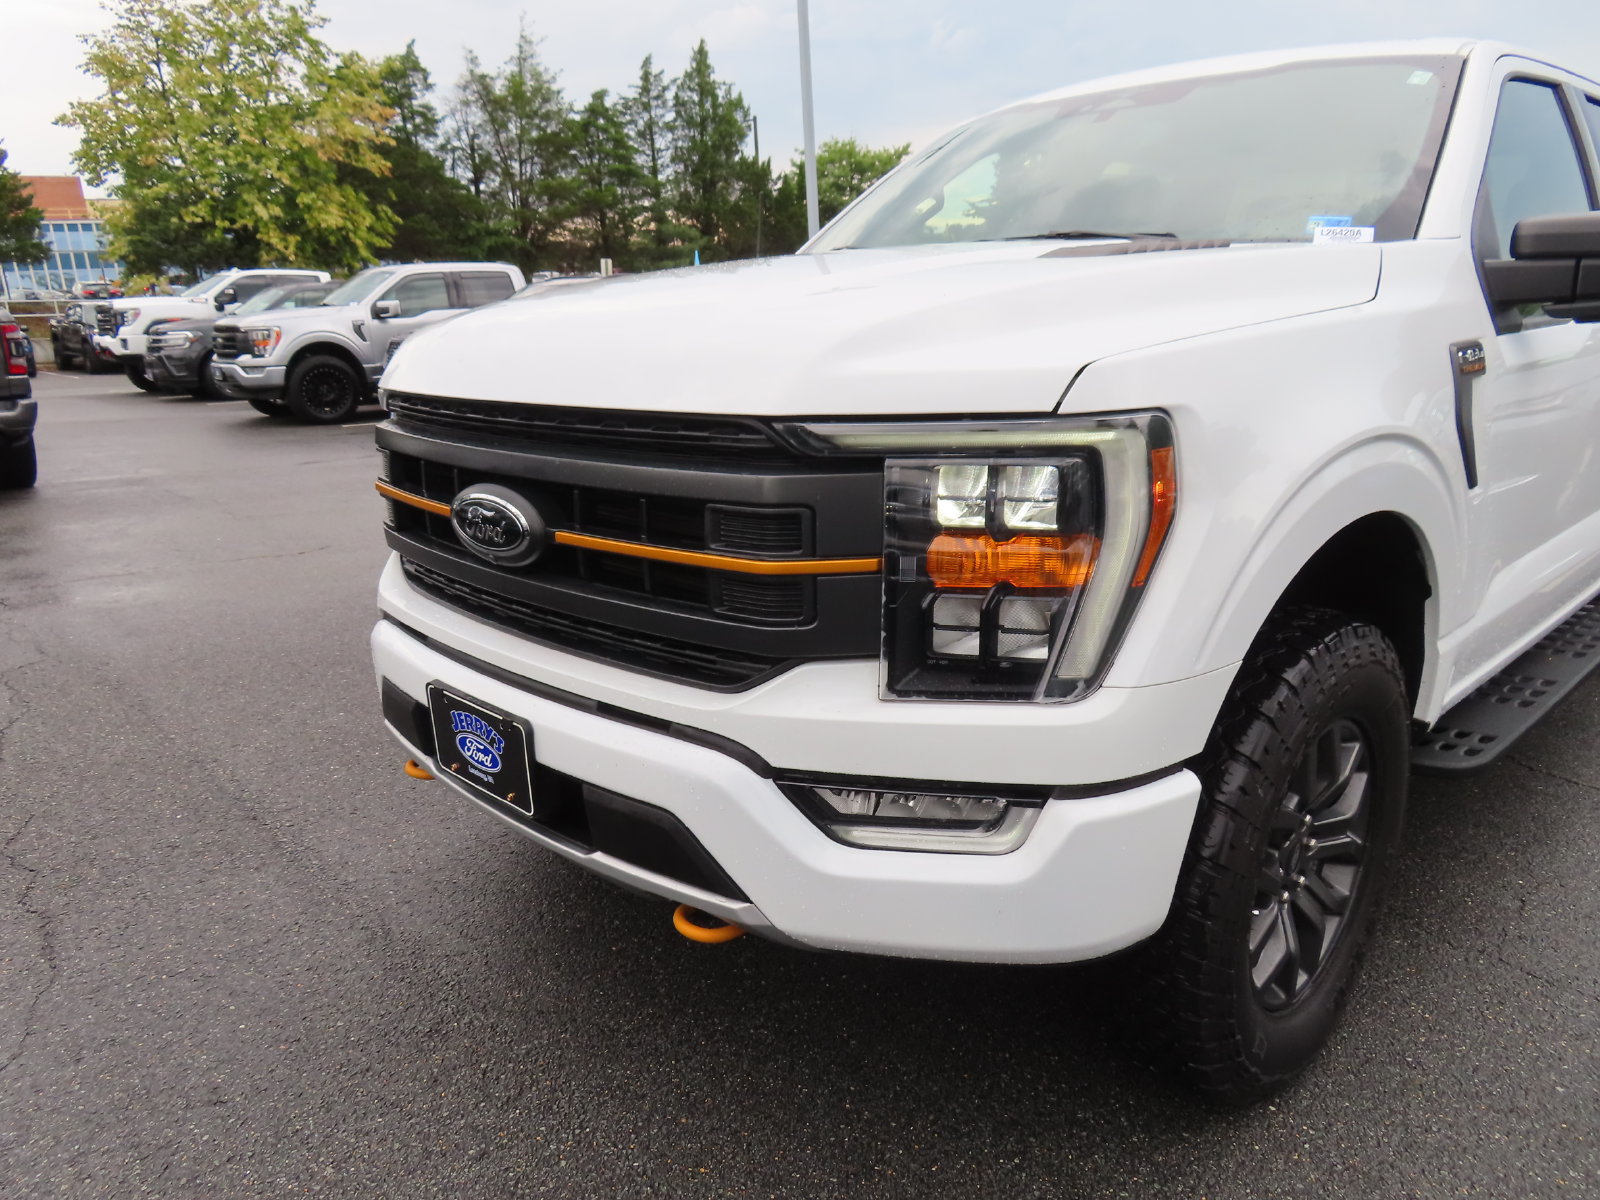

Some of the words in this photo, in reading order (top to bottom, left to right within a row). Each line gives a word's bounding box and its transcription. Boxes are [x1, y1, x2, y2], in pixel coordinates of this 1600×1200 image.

[465, 505, 507, 544] Ford
[450, 709, 505, 755] JERRY'S
[464, 738, 493, 768] Ford
